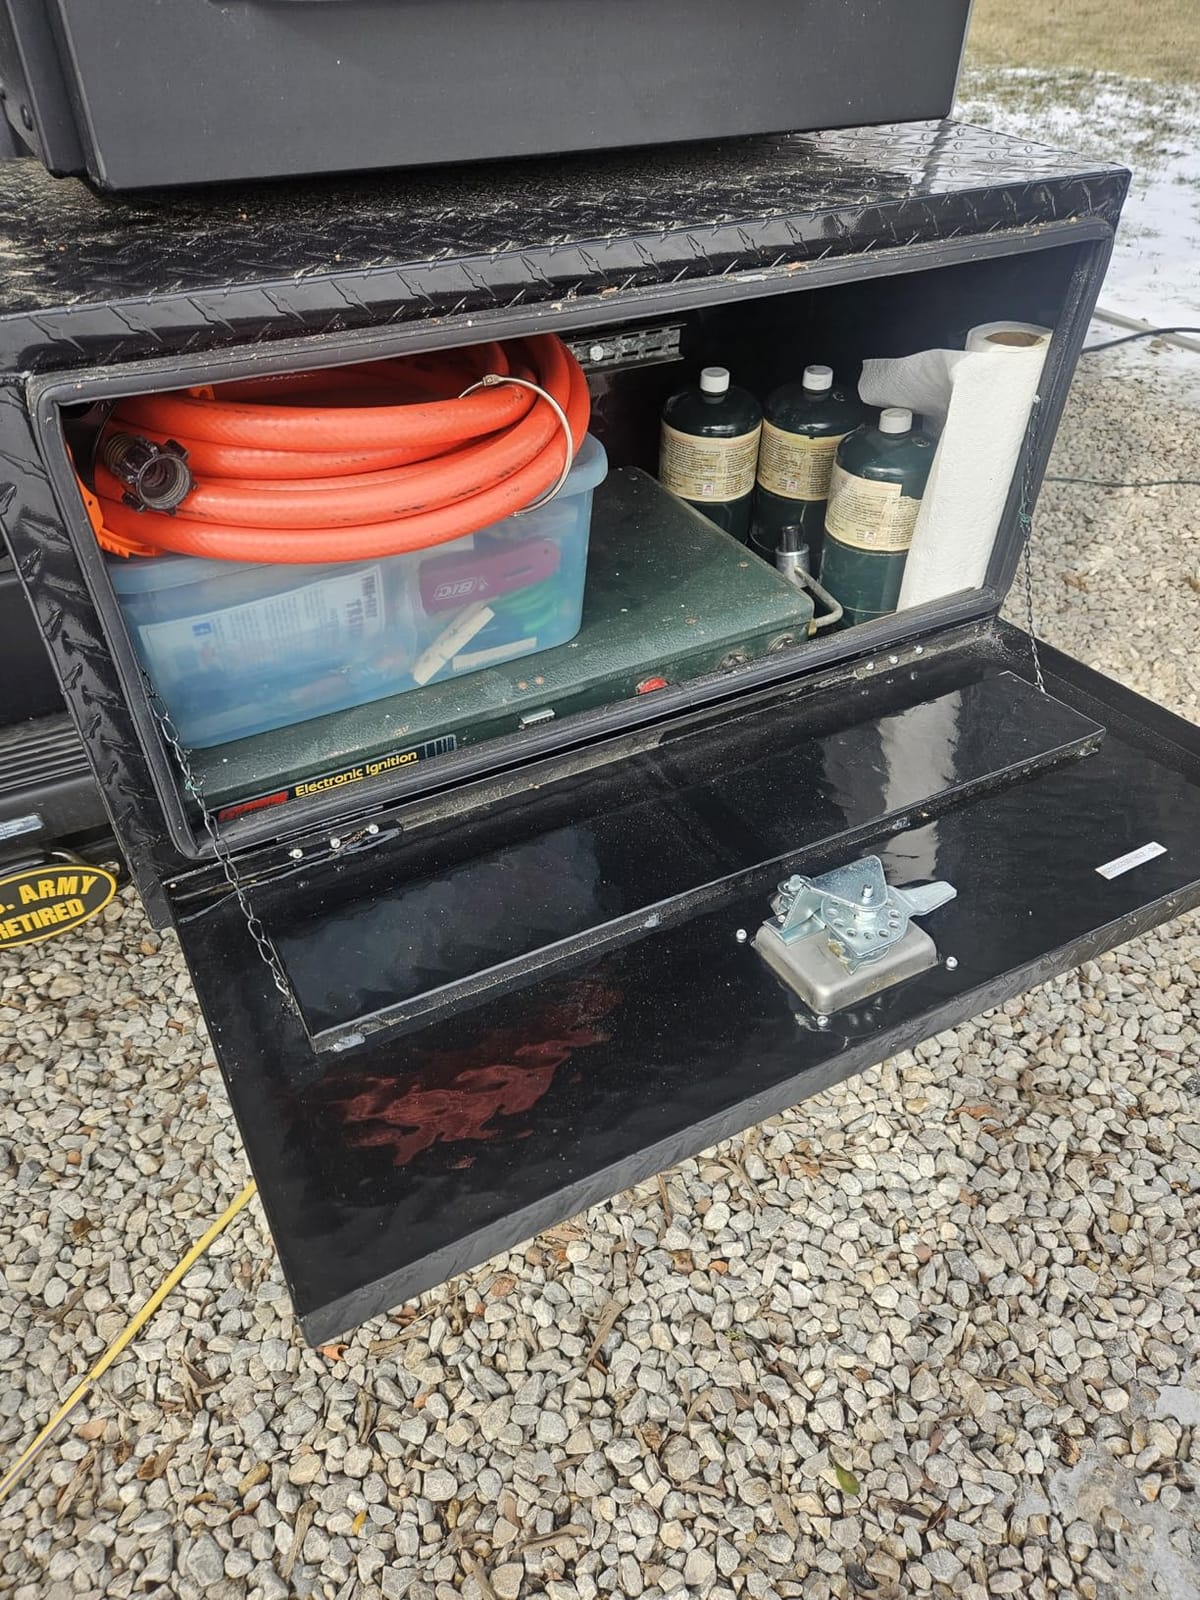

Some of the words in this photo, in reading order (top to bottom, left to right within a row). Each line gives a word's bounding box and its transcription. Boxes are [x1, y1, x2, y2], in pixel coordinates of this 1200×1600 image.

[438, 580, 473, 597] BIC
[294, 768, 364, 797] Electronic
[365, 751, 418, 776] Ignition
[18, 875, 98, 905] ARMY
